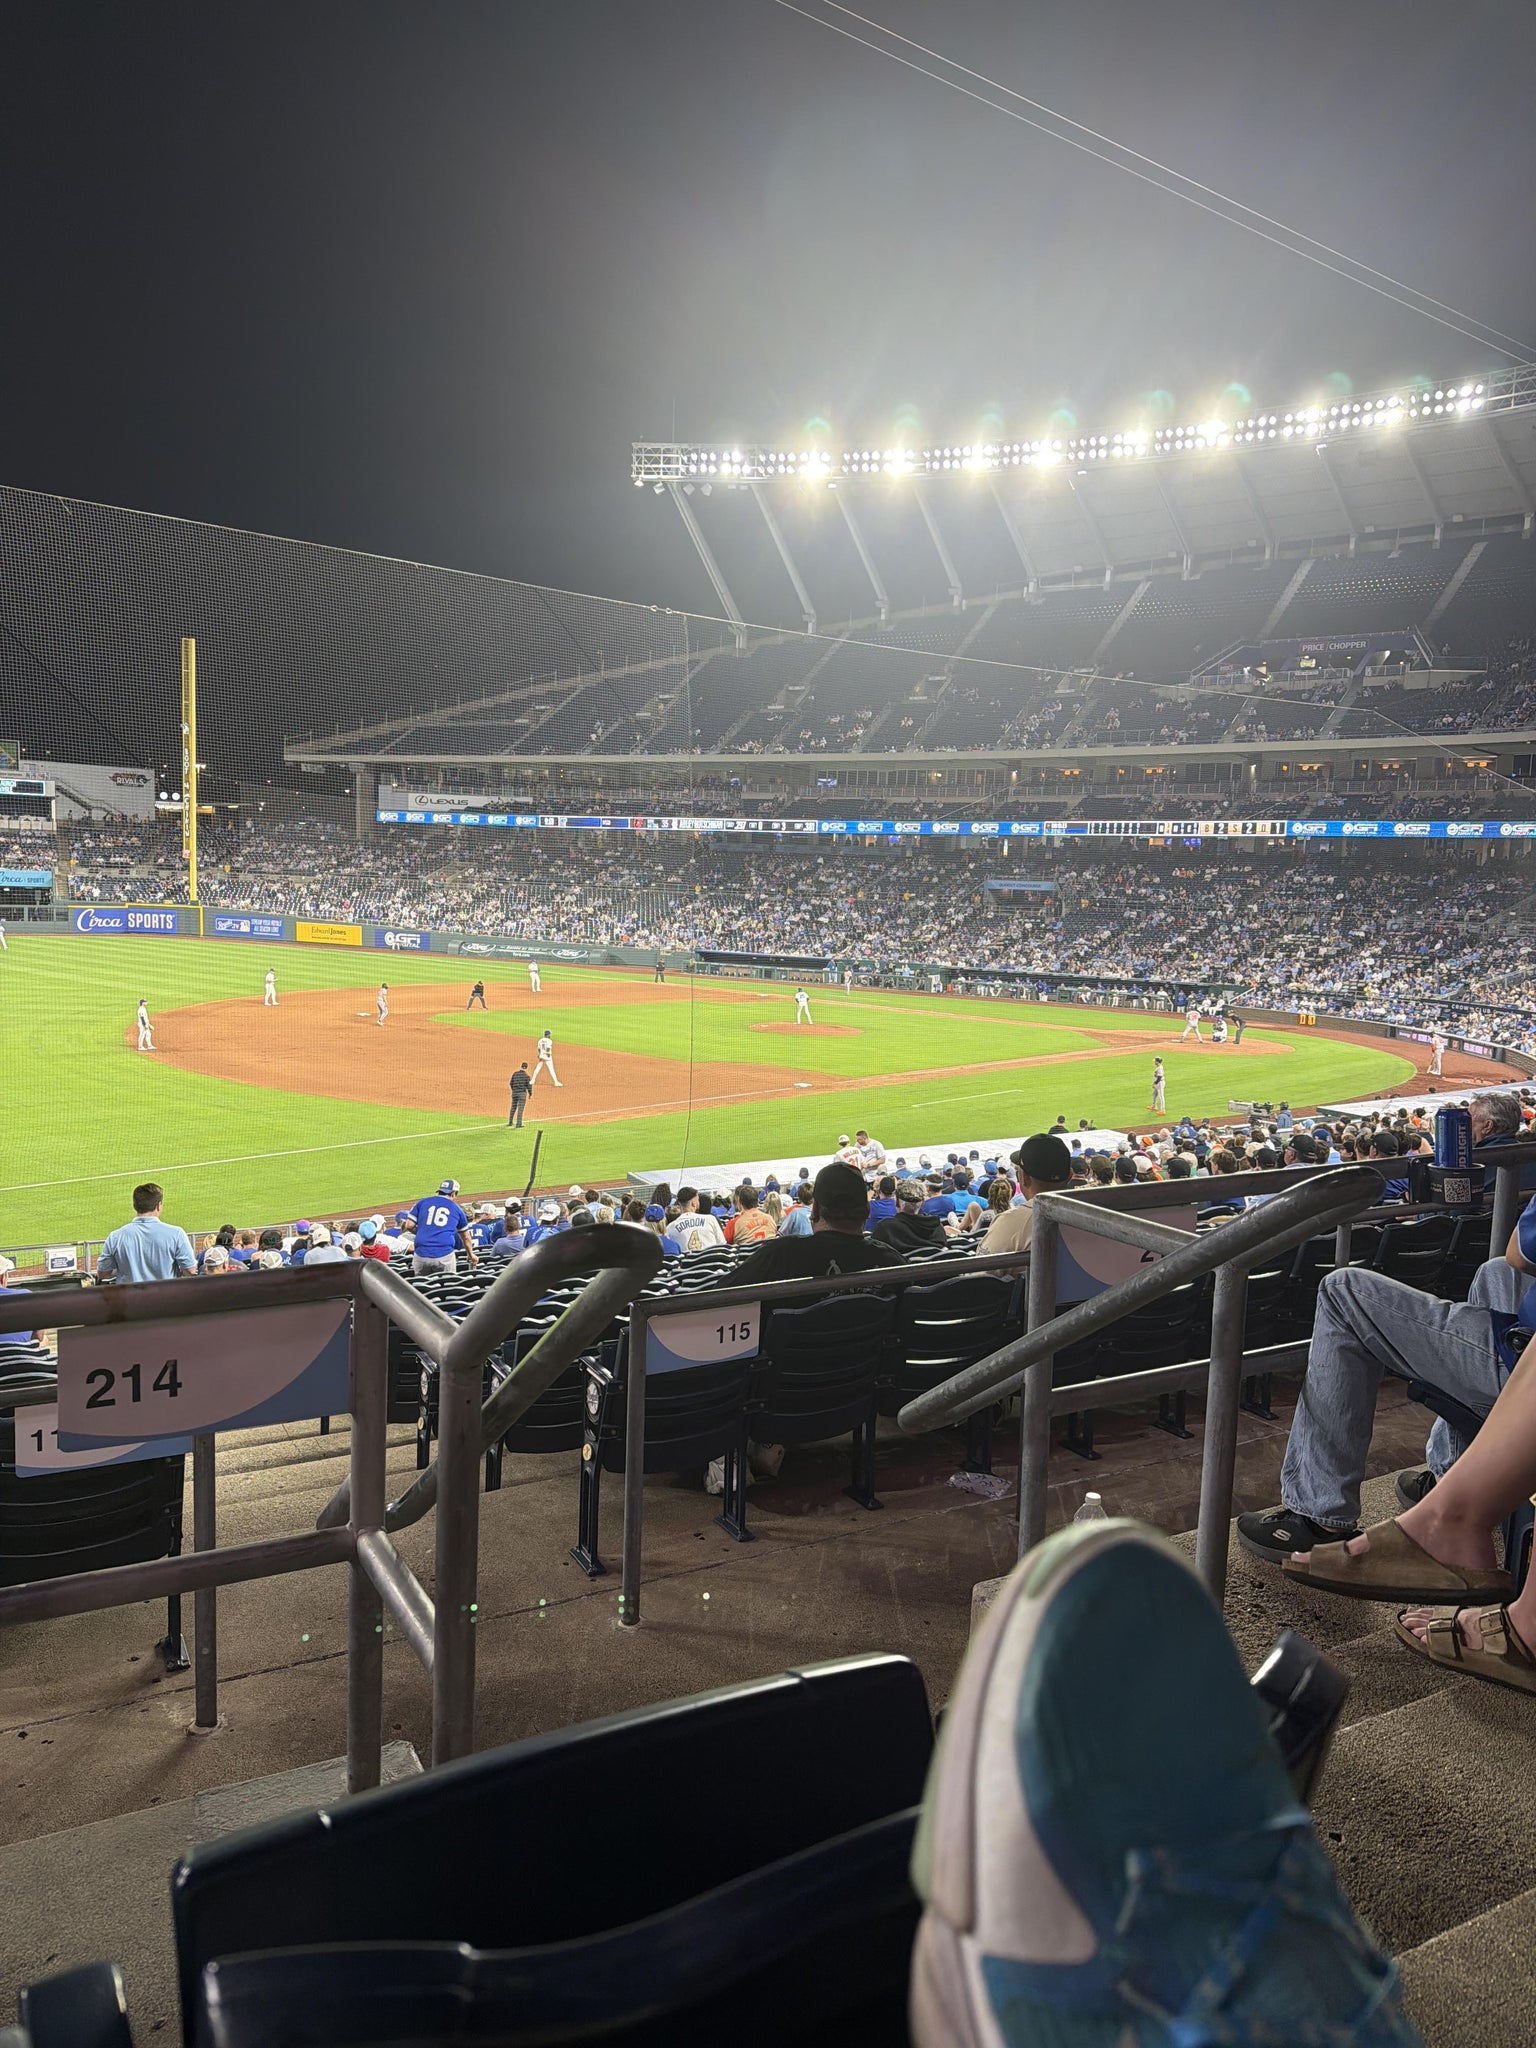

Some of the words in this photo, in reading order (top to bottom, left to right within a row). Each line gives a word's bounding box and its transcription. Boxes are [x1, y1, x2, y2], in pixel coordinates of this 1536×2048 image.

[1302, 644, 1325, 652] PRICE
[1329, 641, 1367, 650] CHOPPER
[116, 777, 145, 785] RIVALS
[430, 798, 469, 806] LEXUS
[1218, 823, 1225, 834] 2
[1246, 823, 1253, 834] 2
[76, 908, 123, 932] Circa
[128, 912, 172, 930] SPORTS
[1458, 1124, 1467, 1155] LIGHT
[1459, 1156, 1467, 1168] UD
[426, 1205, 450, 1227] 16
[675, 1217, 706, 1233] GORDON
[687, 1229, 702, 1250] 4
[716, 1321, 751, 1344] 115
[85, 1358, 183, 1409] 214
